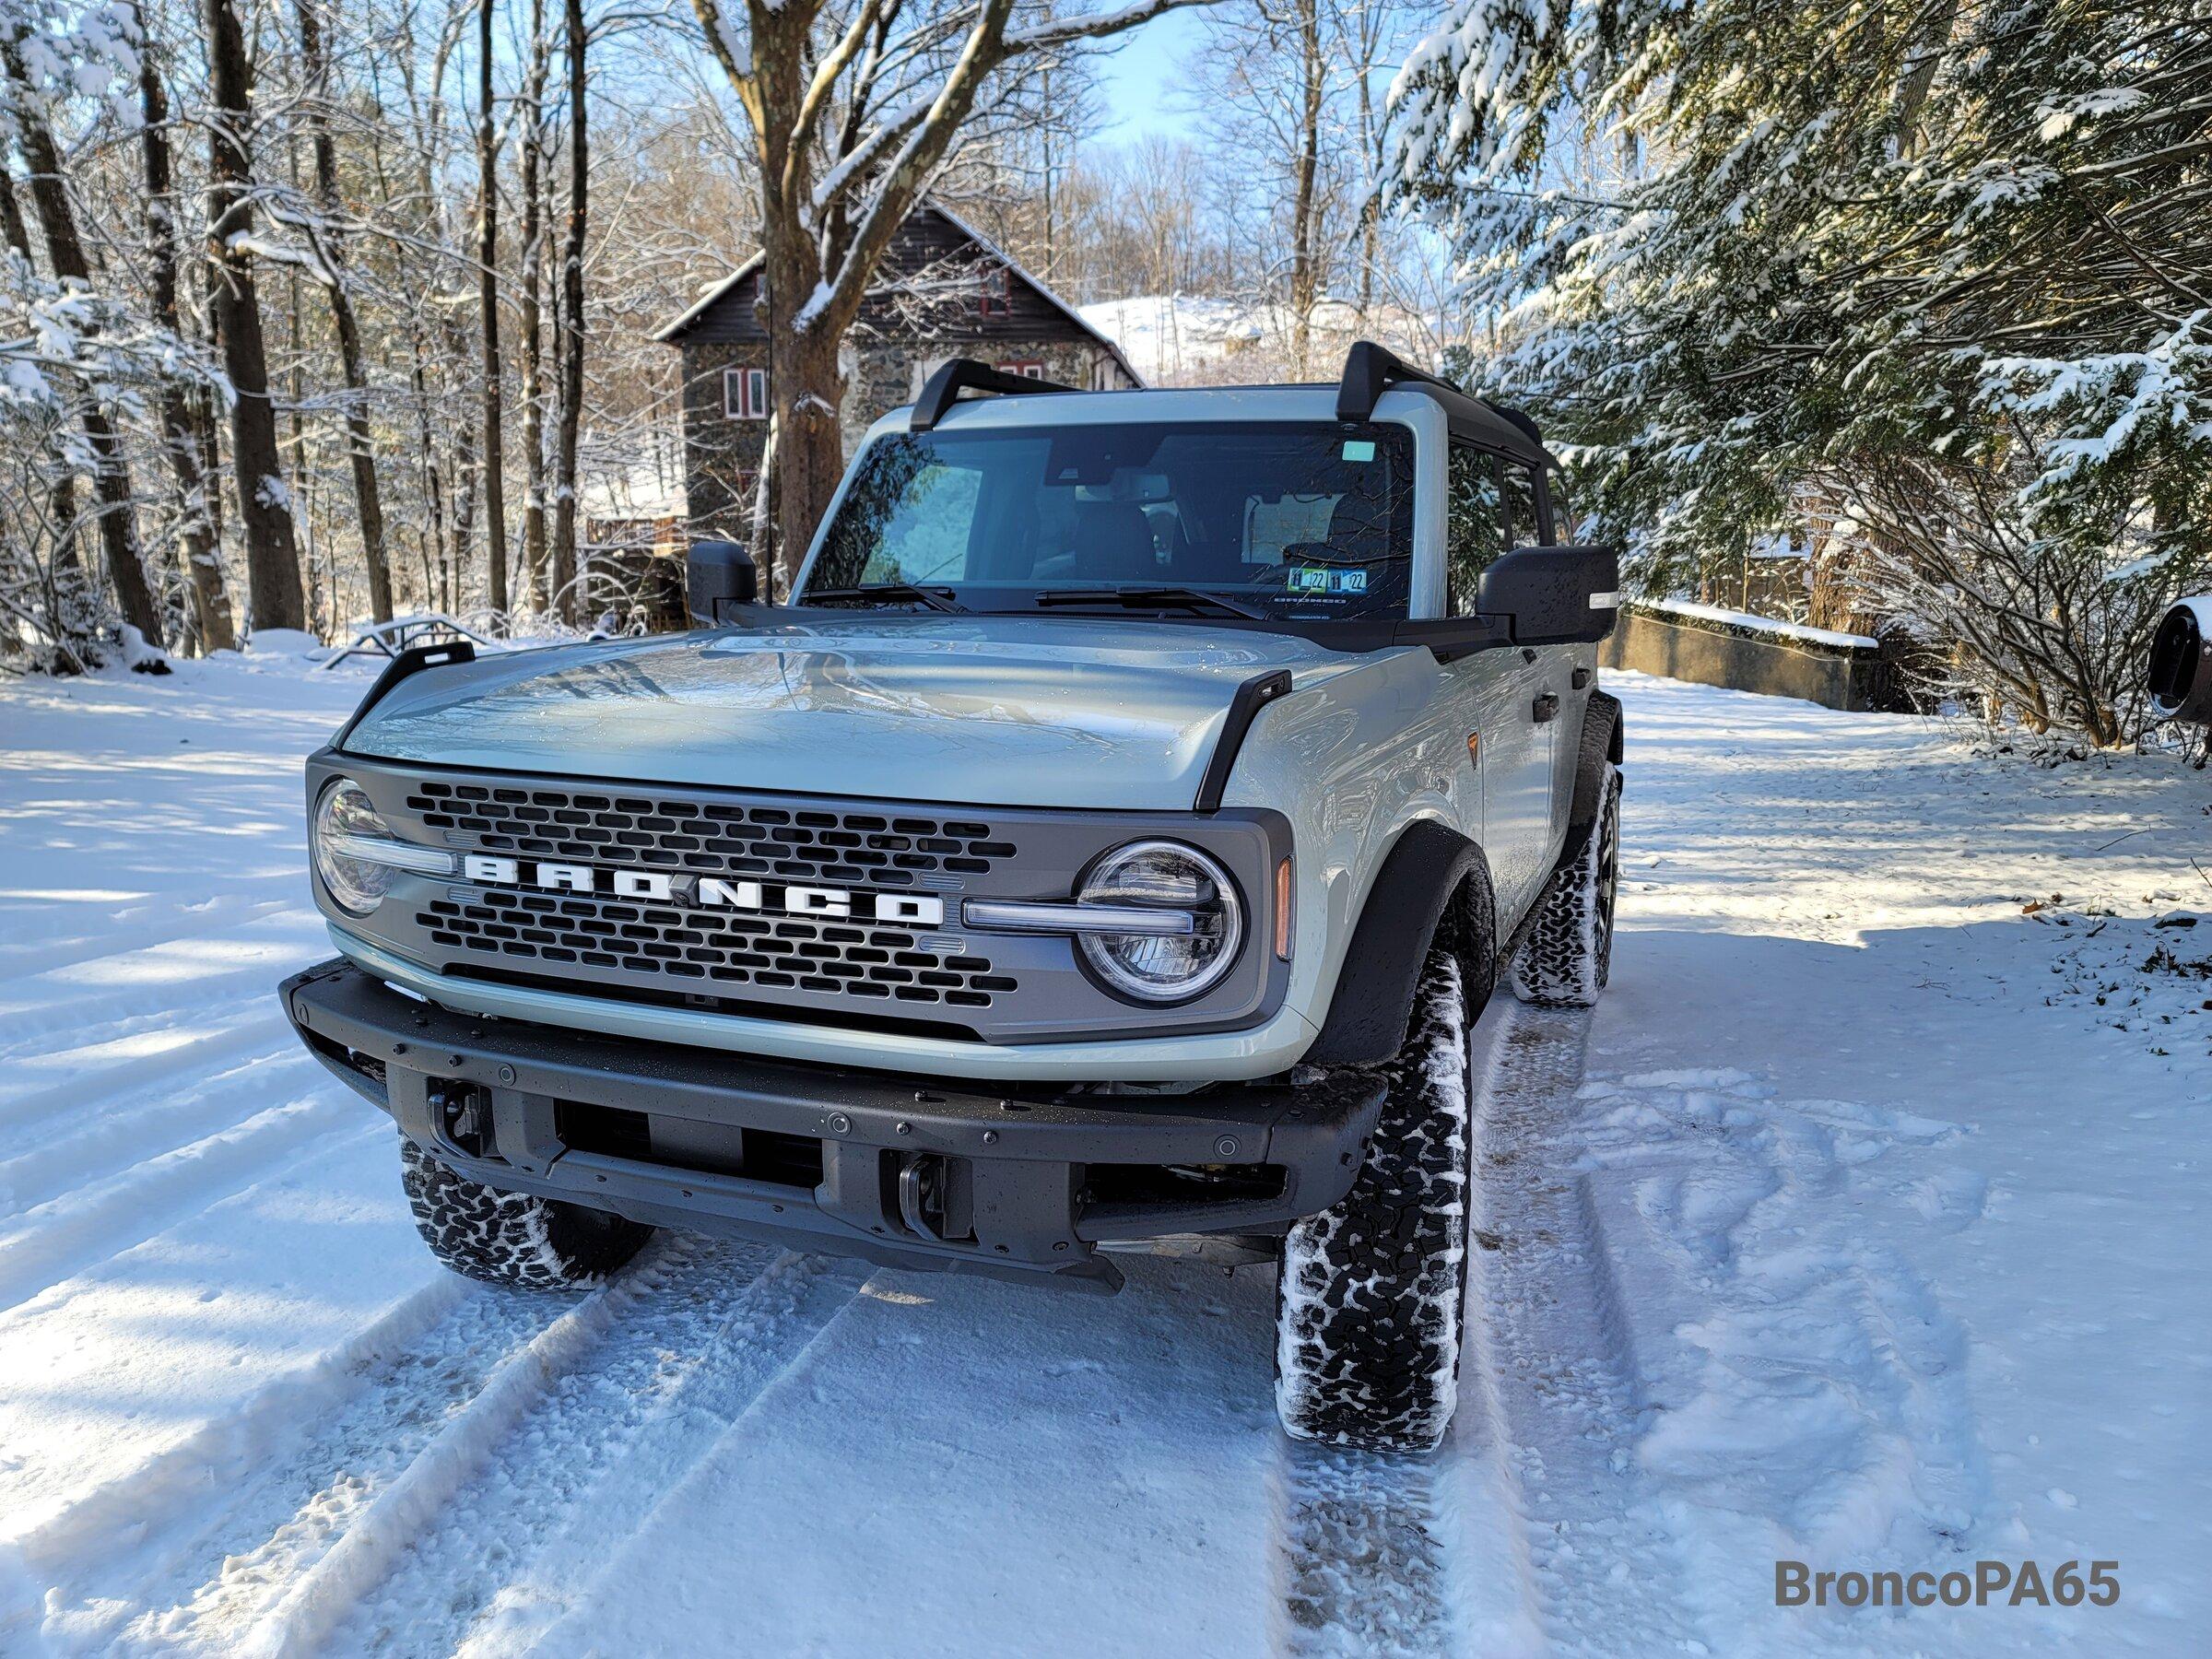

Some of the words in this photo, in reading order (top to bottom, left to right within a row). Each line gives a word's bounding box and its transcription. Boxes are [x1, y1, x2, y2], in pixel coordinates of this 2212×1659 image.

[1312, 572, 1324, 588] 22
[1331, 575, 1341, 590] 11
[1351, 573, 1363, 590] 22
[464, 854, 944, 925] BRONCO
